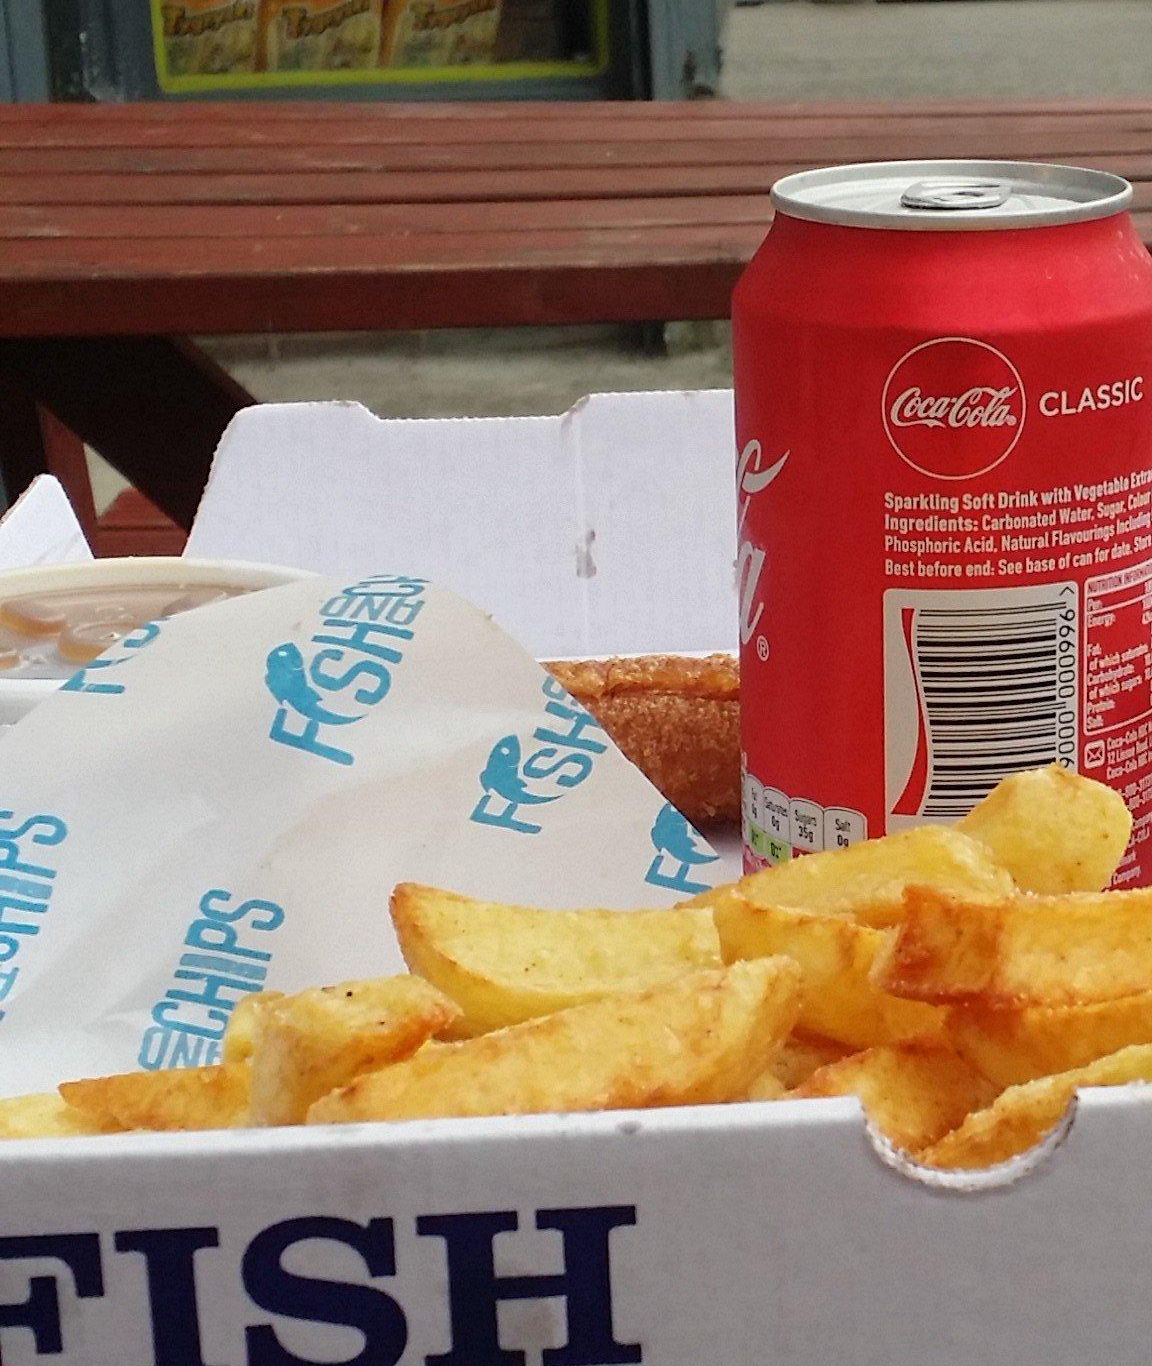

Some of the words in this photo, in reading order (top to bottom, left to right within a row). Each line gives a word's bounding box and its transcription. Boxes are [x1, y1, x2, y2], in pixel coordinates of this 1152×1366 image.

[890, 386, 1018, 428] Coca-Cola
[1039, 376, 1145, 417] CLASSIC
[884, 492, 959, 514] Sparkling
[962, 492, 995, 511] Soft
[998, 490, 1038, 510] Drink
[1040, 486, 1073, 507] with
[1074, 475, 1130, 502] Vegetable
[884, 514, 978, 535] Ingredients:
[981, 510, 1057, 532] Carbonated
[884, 535, 961, 557] Phosphoric
[1001, 531, 1050, 552] Natural
[1052, 519, 1115, 547] Flavourings
[884, 559, 915, 577] Best
[918, 557, 963, 577] before
[965, 558, 995, 577] end:
[997, 558, 1023, 575] See
[1025, 554, 1055, 573] base
[1057, 553, 1072, 571] of
[1072, 550, 1093, 567] can
[1094, 546, 1110, 564] for
[1058, 608, 1075, 699] 000996
[798, 826, 814, 843] 35g
[152, 888, 285, 1041] CHIPS
